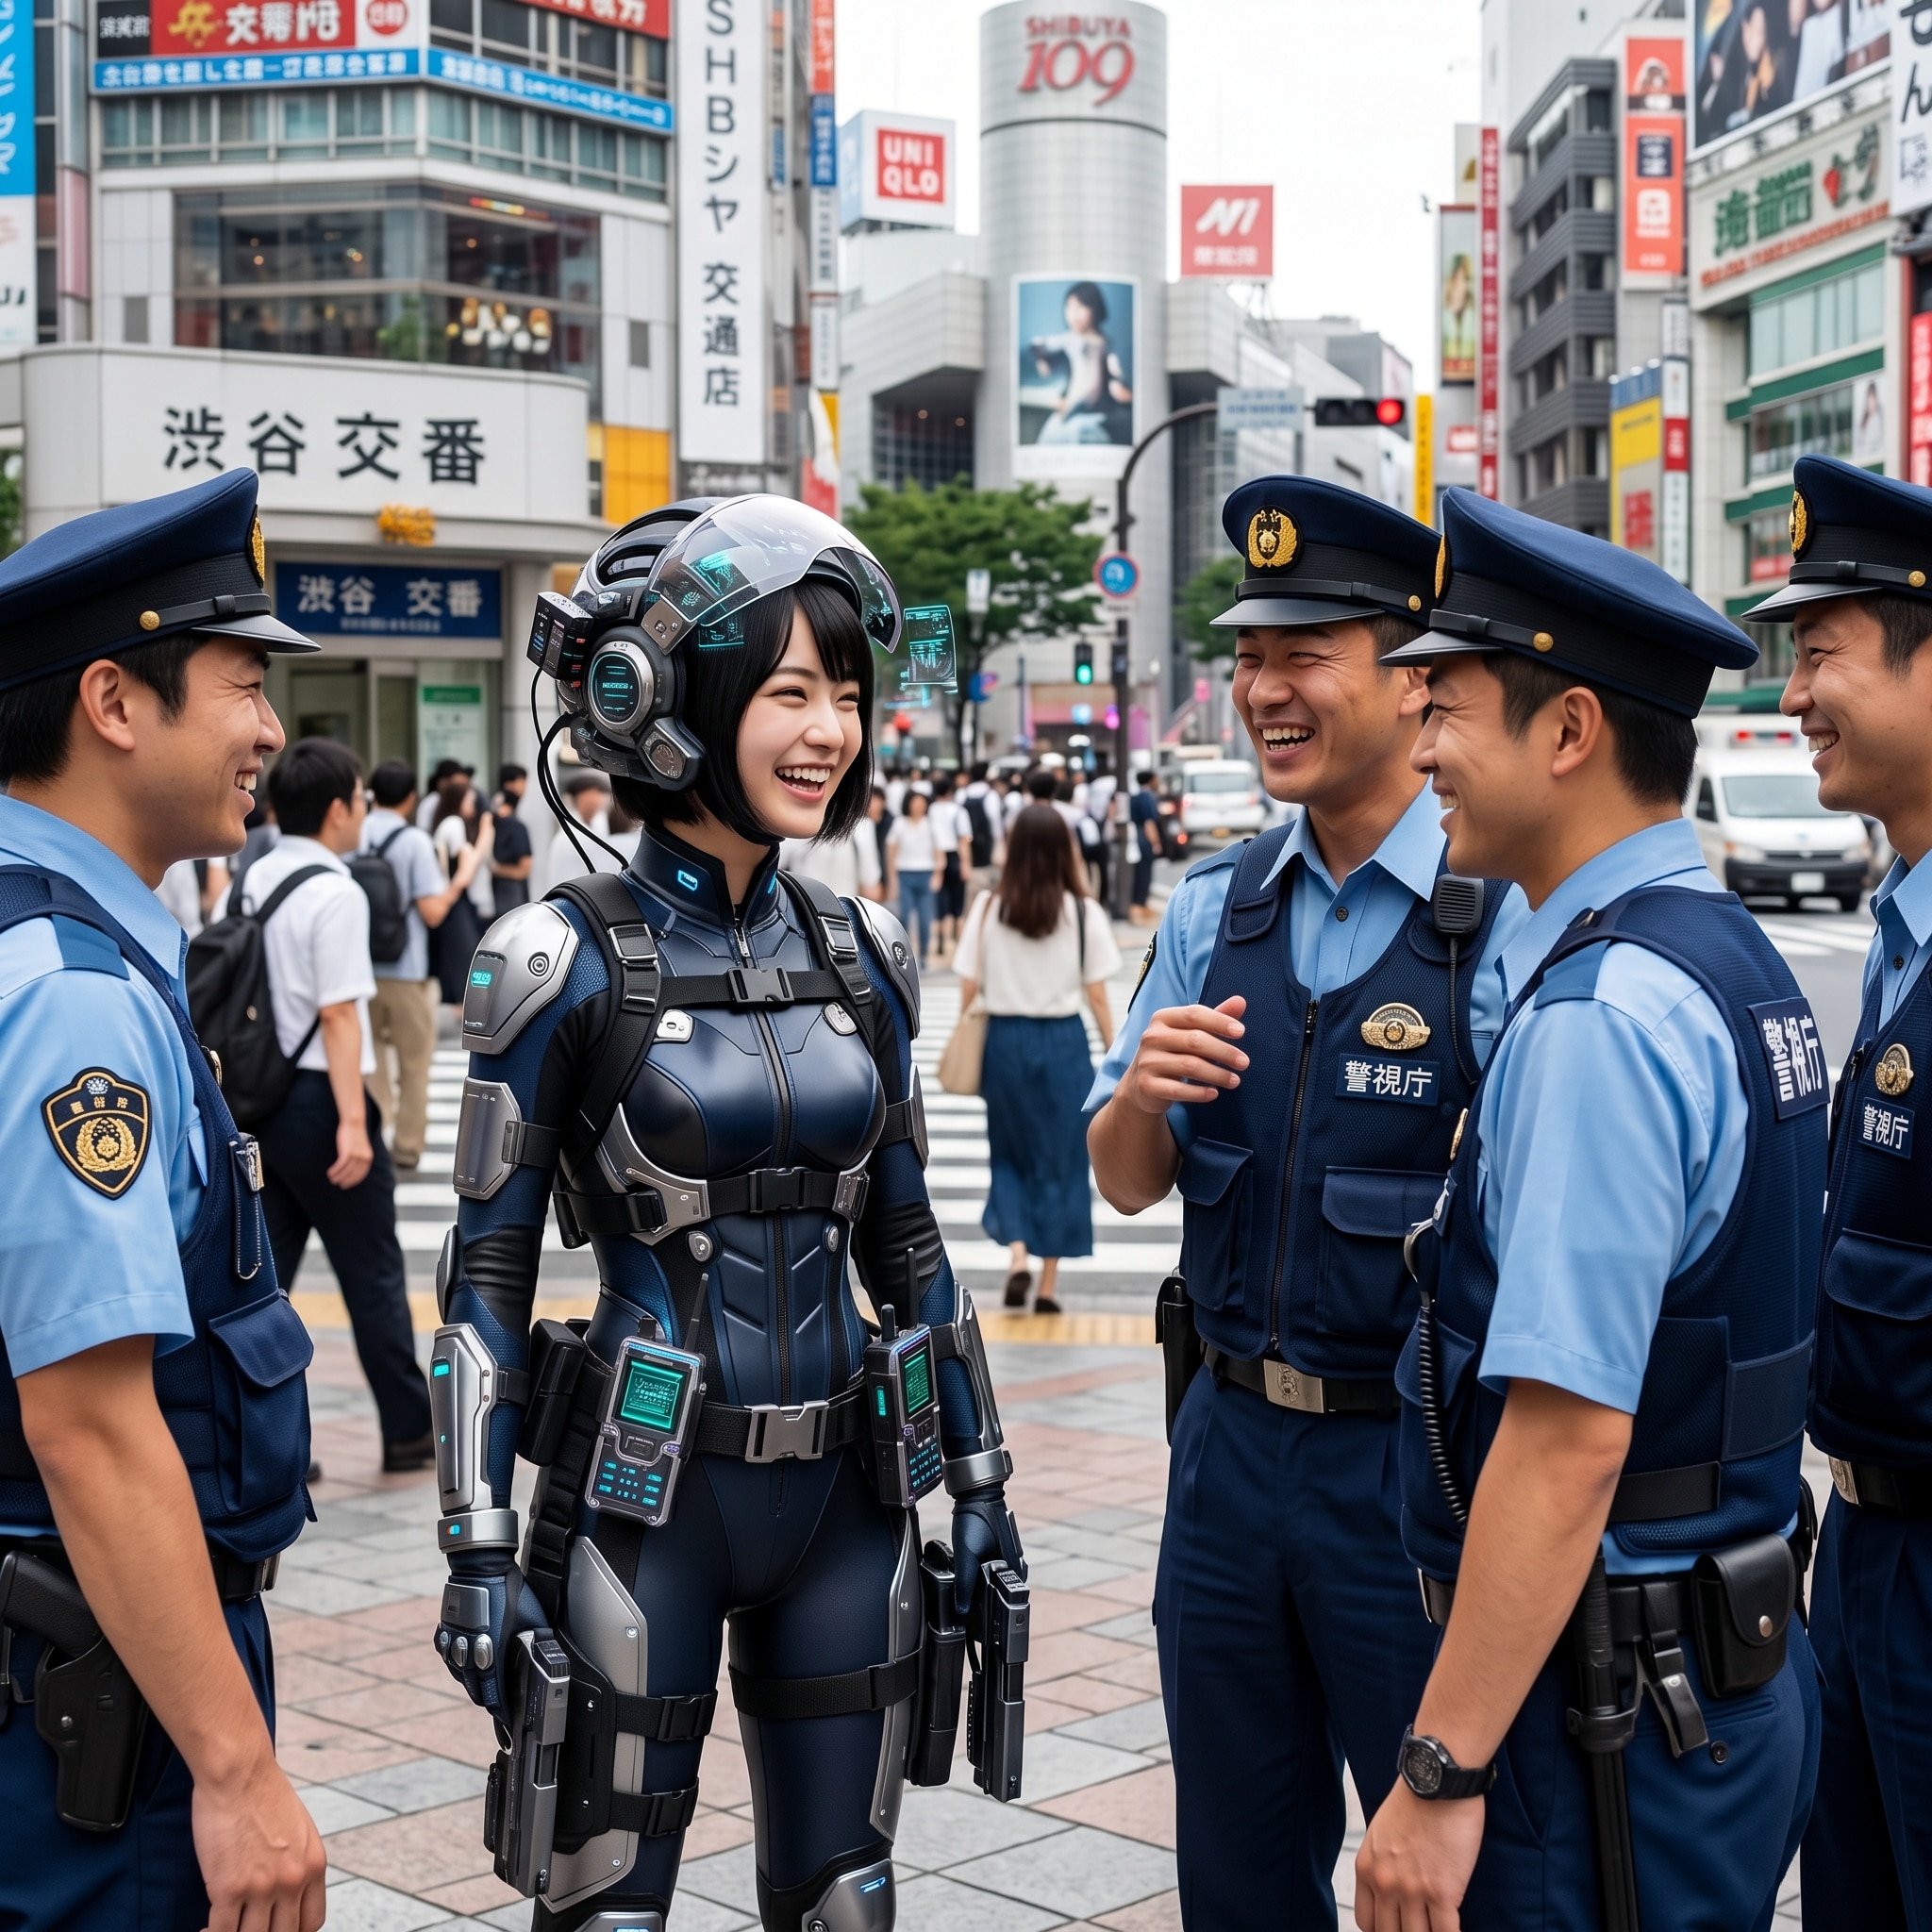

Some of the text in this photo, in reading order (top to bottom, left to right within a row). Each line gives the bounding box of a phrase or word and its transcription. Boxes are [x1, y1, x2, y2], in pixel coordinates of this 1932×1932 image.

[1025, 15, 1131, 39] SHIBUYA
[1017, 39, 1136, 108] 109
[882, 134, 936, 168] UNI
[881, 164, 941, 198] QLO
[703, 261, 739, 406] 交通店
[296, 574, 483, 619] 渋谷 交番
[1343, 1059, 1433, 1098] 警視庁
[1762, 1014, 1823, 1103] 警視庁
[1862, 1103, 1909, 1150] 警視庁
